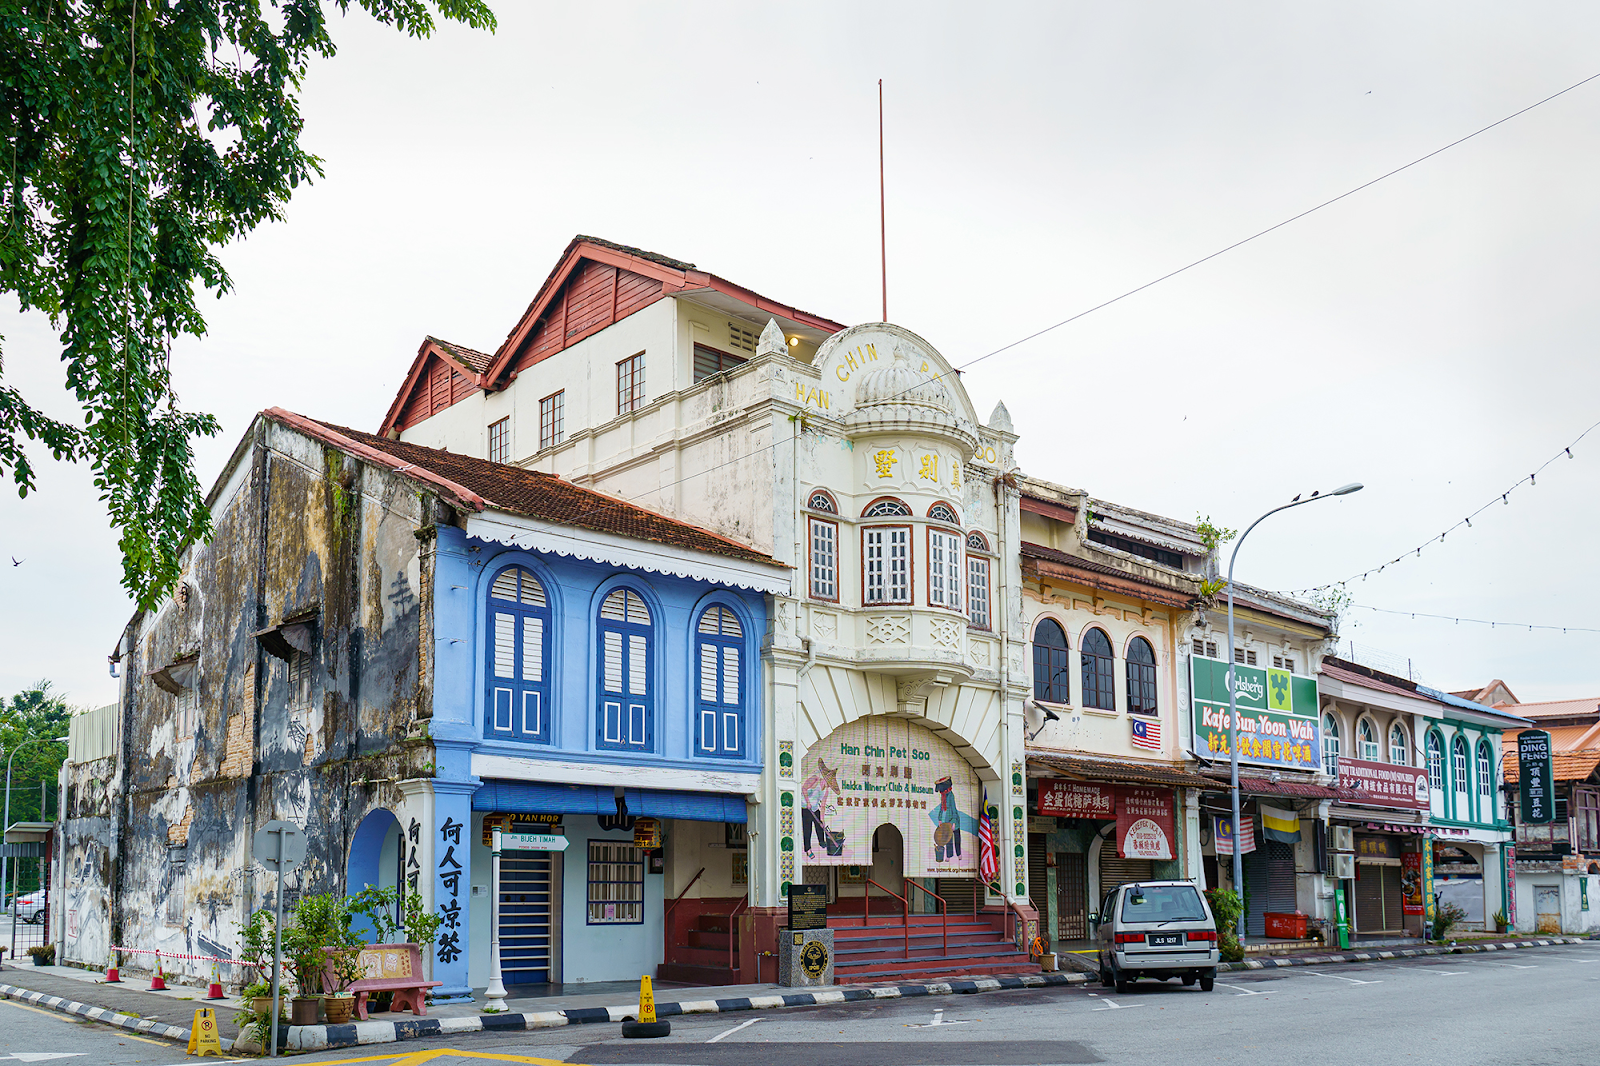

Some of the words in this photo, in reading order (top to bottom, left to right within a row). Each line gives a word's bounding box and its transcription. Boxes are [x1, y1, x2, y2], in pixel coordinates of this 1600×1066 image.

[796, 382, 830, 410] HAN
[836, 343, 879, 382] CHIN
[1225, 671, 1263, 699] Crlsberg
[1202, 706, 1231, 733] Kafe
[1235, 711, 1256, 733] Sun
[1259, 715, 1287, 738] Yoon
[1288, 719, 1314, 741] Wah
[841, 742, 860, 756] Han
[864, 745, 885, 758] Chin
[889, 746, 907, 759] Pet
[911, 748, 930, 761] Soo
[1520, 743, 1547, 752] DING
[1521, 752, 1548, 760] FENG
[1349, 766, 1378, 779] TRADITIONAL
[1378, 770, 1390, 780] FOOD
[841, 780, 863, 791] Hakka
[888, 782, 903, 792] Club
[904, 783, 909, 792] &
[911, 784, 934, 795] Museum
[519, 814, 538, 822] YAN
[540, 815, 559, 823] HOR
[521, 835, 537, 843] BIJEH
